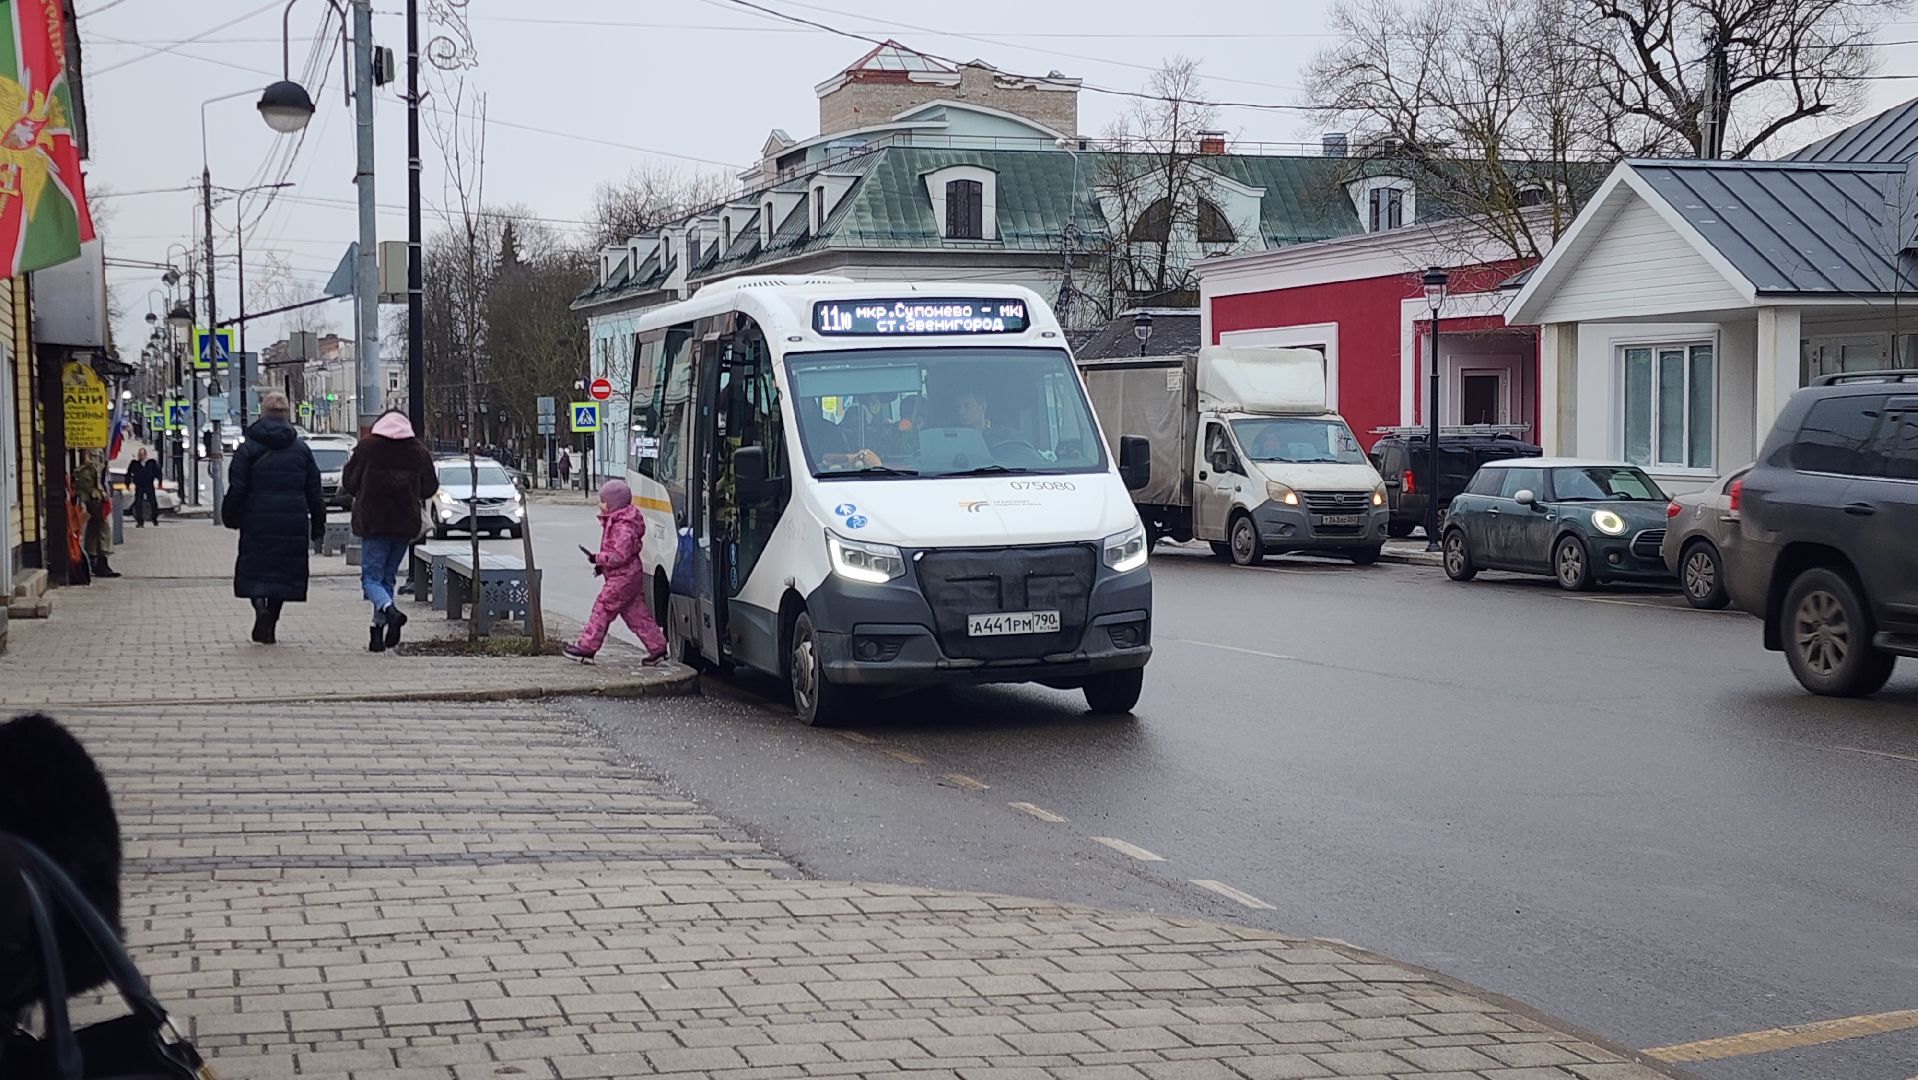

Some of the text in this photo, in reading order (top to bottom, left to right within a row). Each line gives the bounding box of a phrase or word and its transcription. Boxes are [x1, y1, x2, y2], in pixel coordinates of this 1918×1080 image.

[64, 395, 104, 405] АНИ
[1010, 481, 1076, 491] 075080
[1034, 613, 1056, 626] 790
